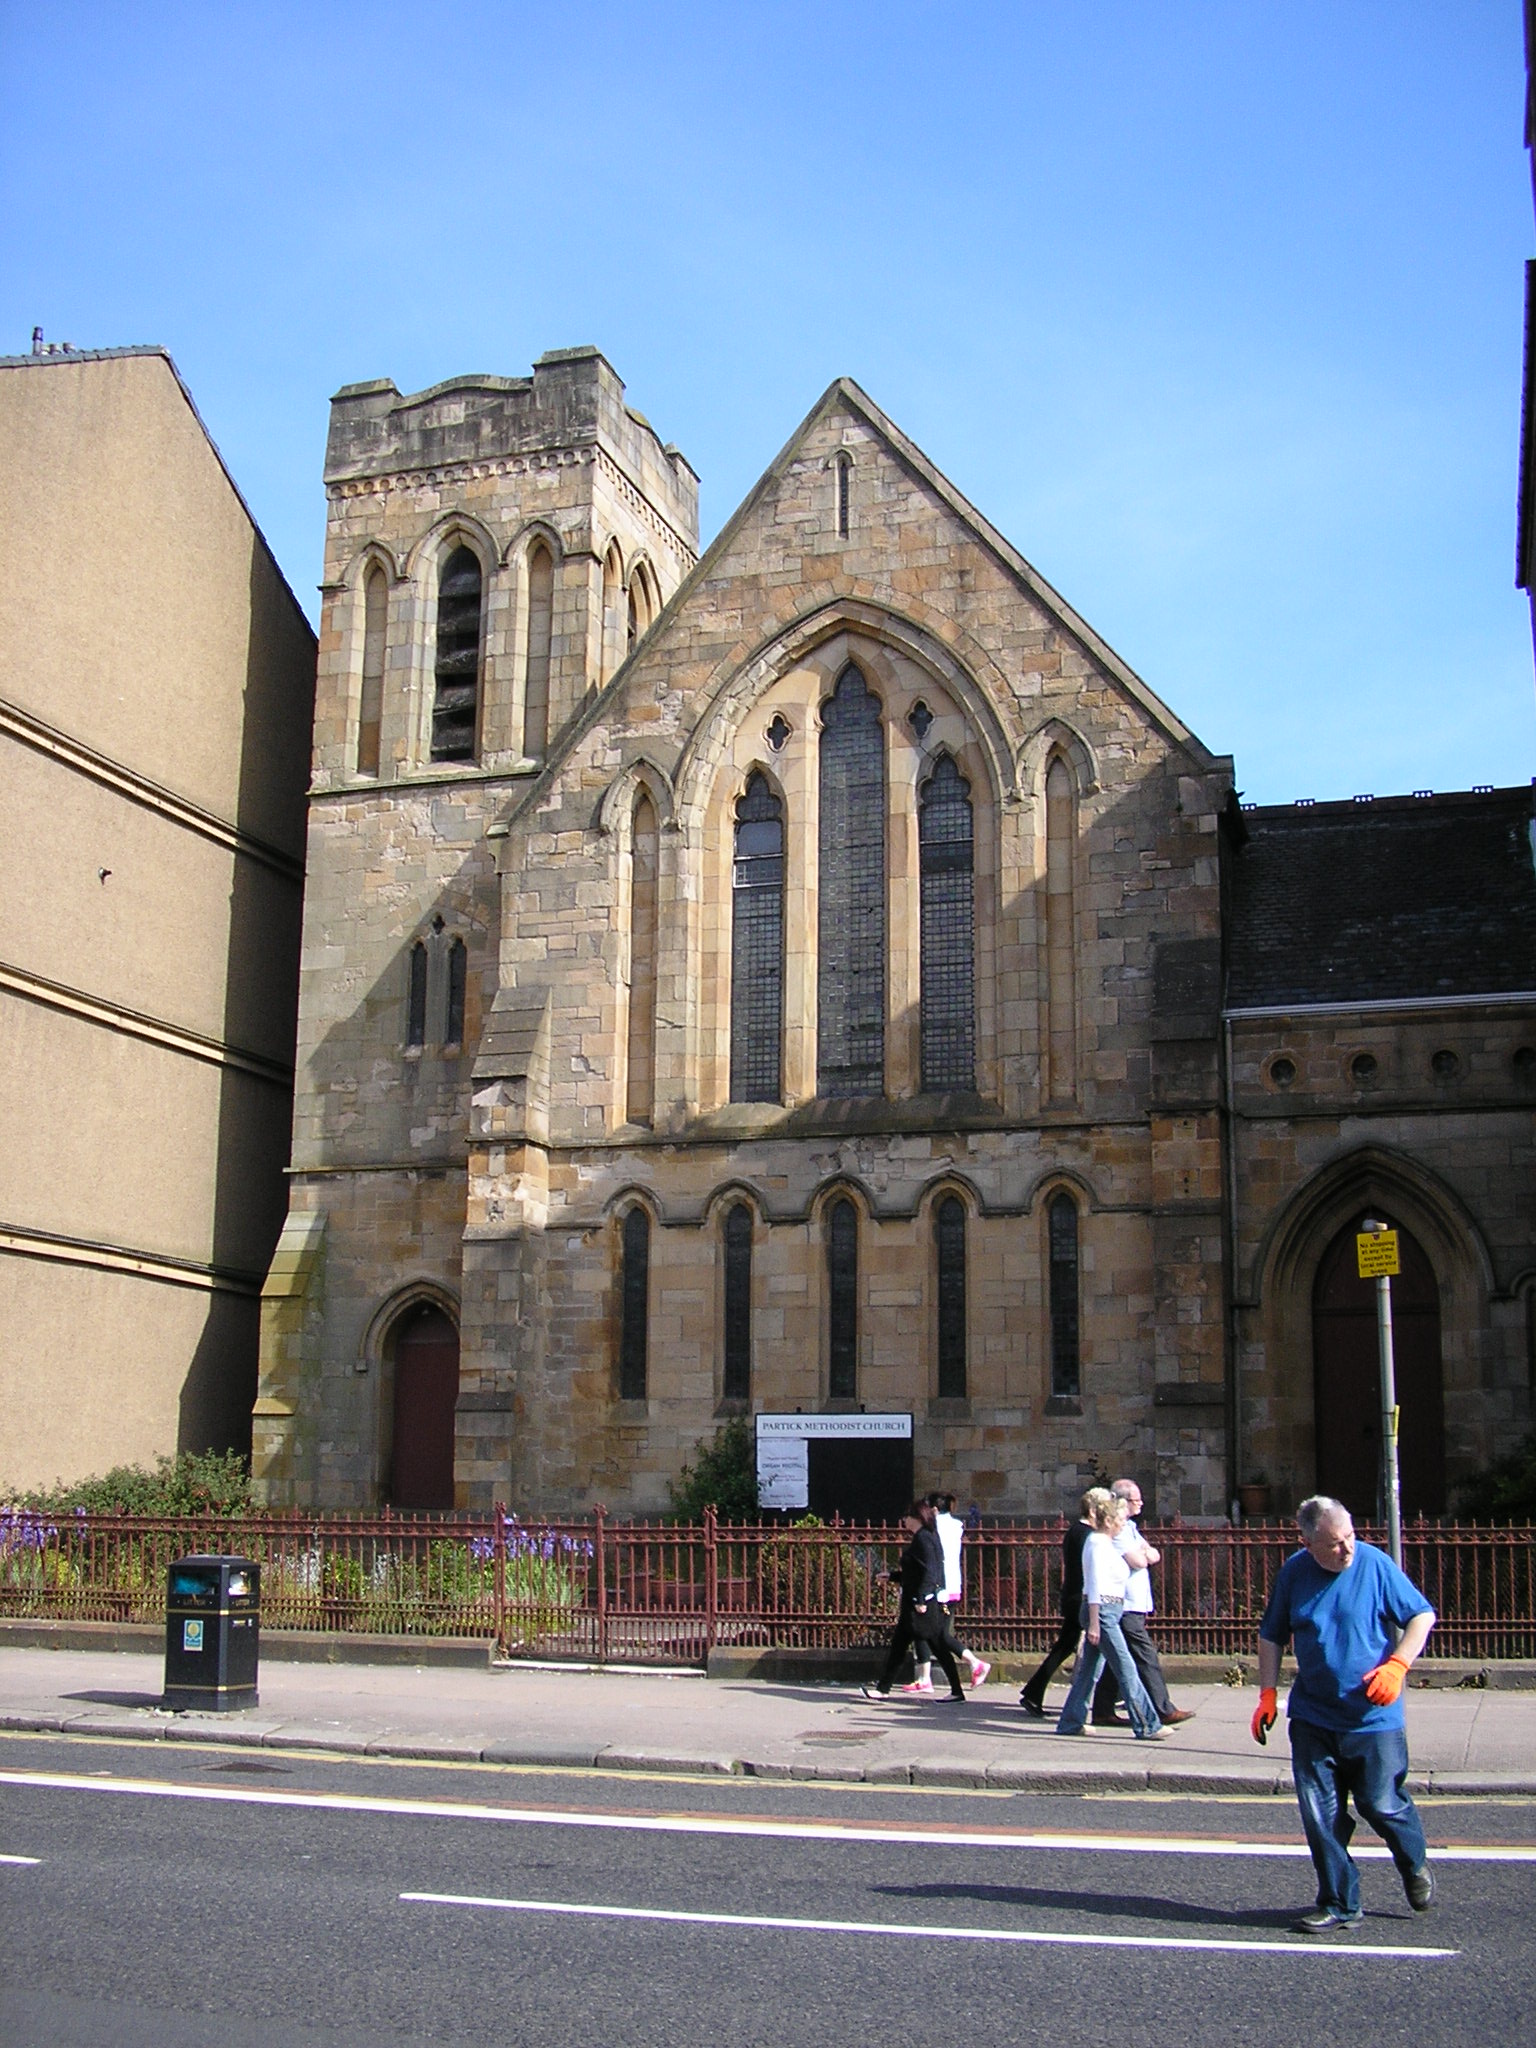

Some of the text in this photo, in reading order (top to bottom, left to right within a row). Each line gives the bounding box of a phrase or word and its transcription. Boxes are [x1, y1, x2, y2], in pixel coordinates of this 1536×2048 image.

[762, 1422, 905, 1431] PARTICK METHODIST CHURCH
